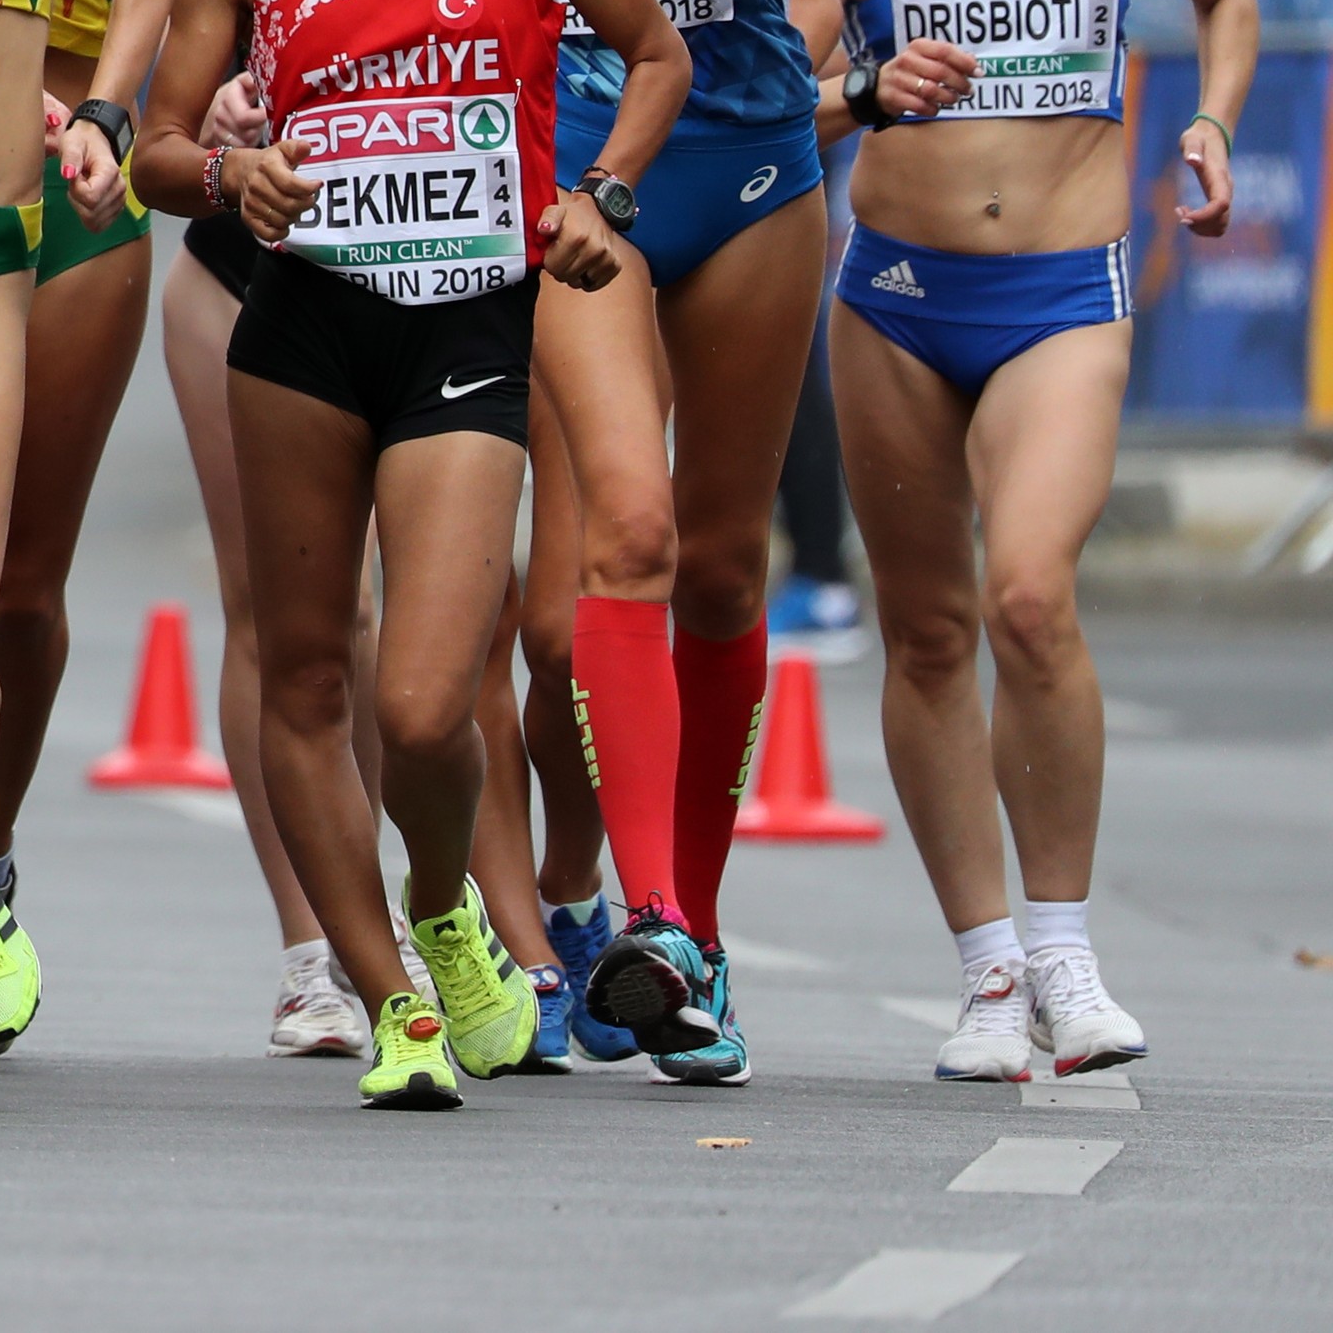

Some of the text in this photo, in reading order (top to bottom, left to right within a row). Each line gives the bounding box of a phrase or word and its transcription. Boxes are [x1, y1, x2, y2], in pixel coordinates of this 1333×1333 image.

[302, 34, 499, 95] TÜRKİYE
[1035, 80, 1094, 107] 2018
[291, 111, 451, 156] SPAR
[347, 244, 392, 263] RUN
[432, 265, 505, 296] 2018
[871, 276, 925, 299] adidas
